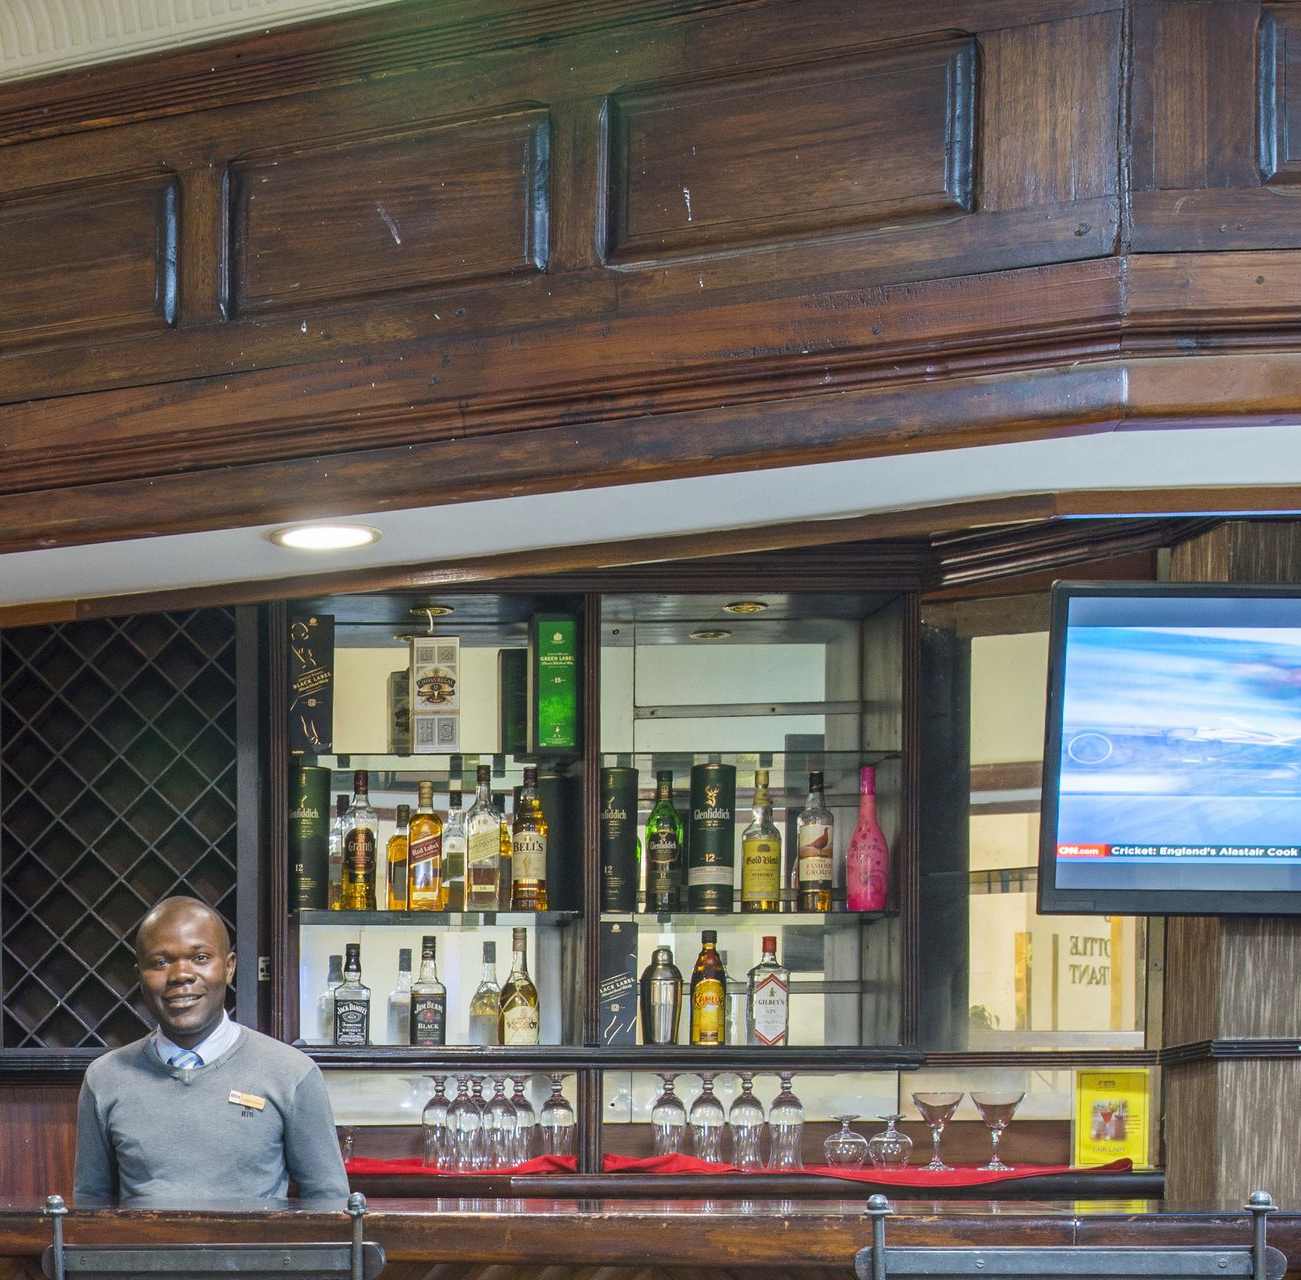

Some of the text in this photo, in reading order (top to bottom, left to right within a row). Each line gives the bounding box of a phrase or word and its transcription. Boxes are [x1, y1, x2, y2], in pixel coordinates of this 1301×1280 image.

[293, 678, 313, 689] BLACK
[313, 671, 332, 682] LABEL
[694, 808, 730, 820] Glenfiddich
[412, 842, 439, 857] Red Label
[513, 841, 544, 853] BELL'S
[1111, 846, 1157, 857] Cricket:
[1159, 846, 1216, 857] England's
[1218, 847, 1264, 857] Alastair
[1267, 847, 1298, 857] Cook
[705, 854, 715, 862] 12
[295, 864, 304, 872] 12
[604, 865, 613, 874] 12
[616, 977, 635, 988] LABEL
[337, 1004, 349, 1015] JACK
[414, 1001, 443, 1014] JIM BEAM
